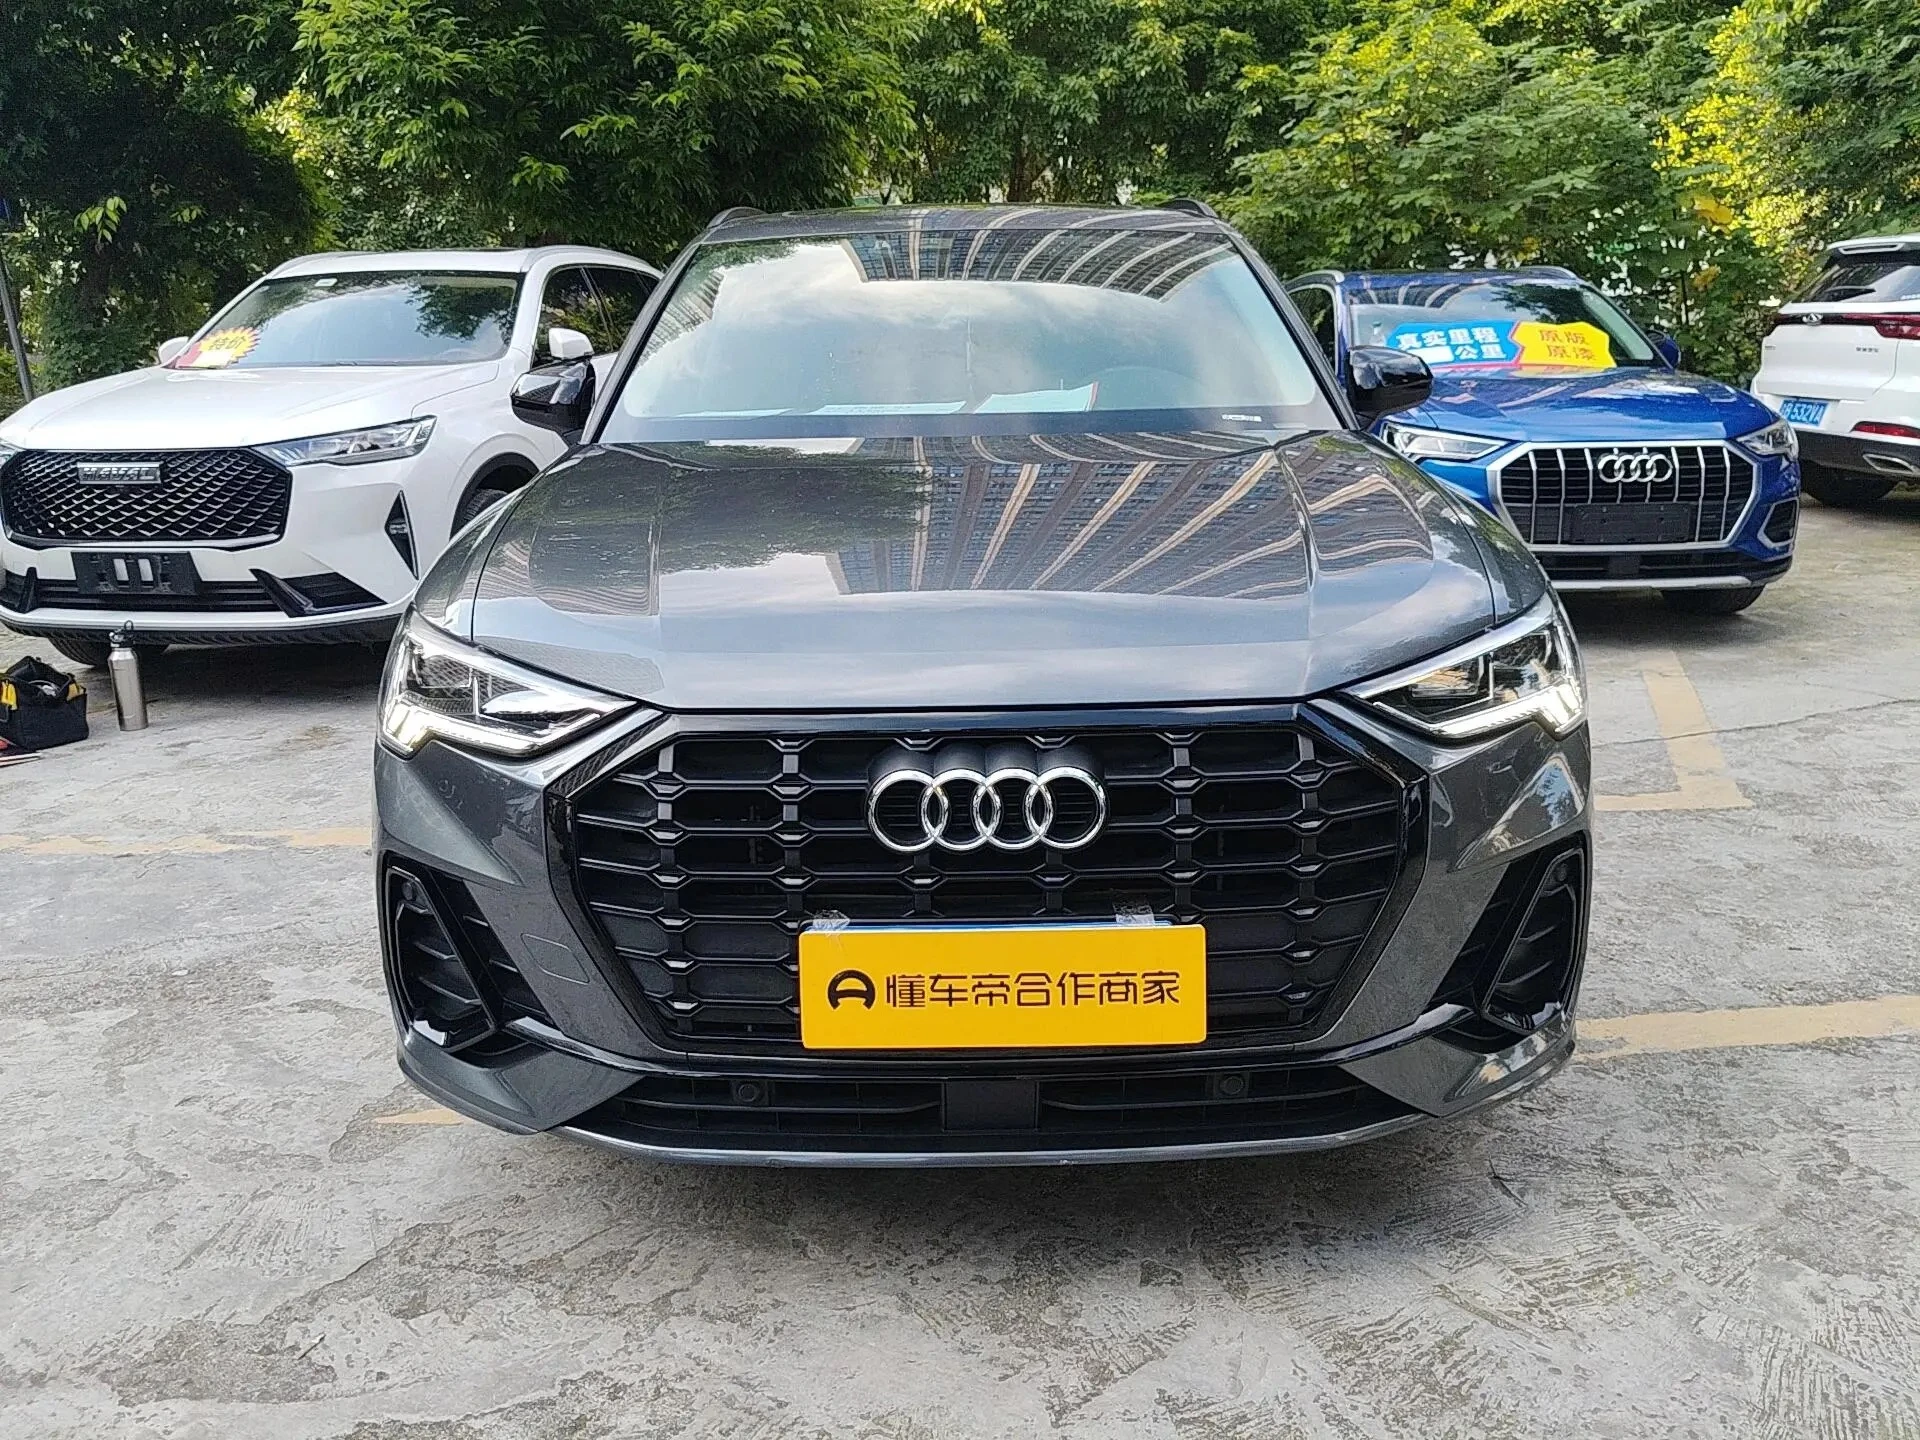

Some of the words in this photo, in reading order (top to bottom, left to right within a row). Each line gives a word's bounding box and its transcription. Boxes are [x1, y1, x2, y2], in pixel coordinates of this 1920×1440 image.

[1396, 327, 1500, 350] 真实里程
[1539, 329, 1587, 346] 原版
[1455, 343, 1507, 360] 公里
[1548, 344, 1597, 361] 原漆
[886, 970, 1181, 1008] 懂车帝合作商家
